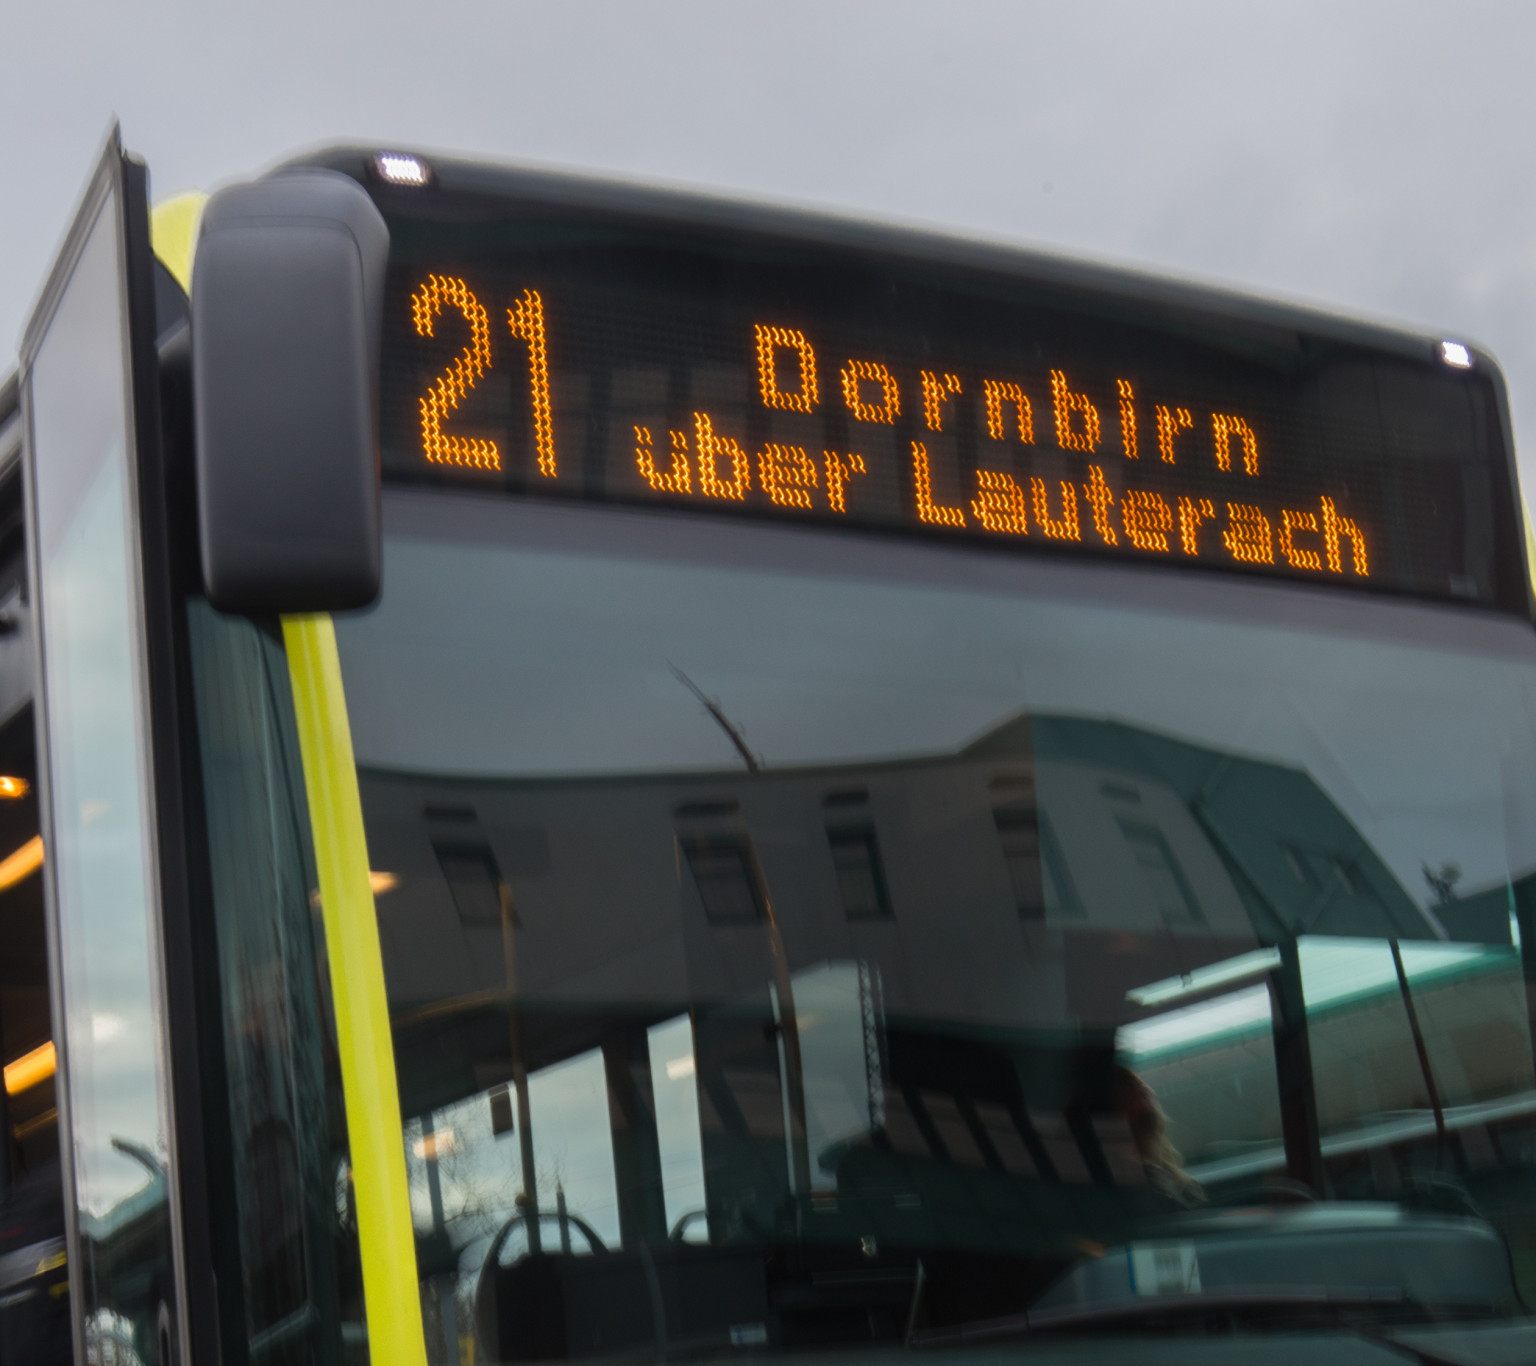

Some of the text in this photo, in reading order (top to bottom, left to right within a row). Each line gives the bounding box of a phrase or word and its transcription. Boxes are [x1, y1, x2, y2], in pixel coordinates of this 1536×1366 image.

[412, 273, 559, 477] 21
[754, 324, 1260, 477] Dornbirn
[634, 411, 1369, 577] über Lauterach
